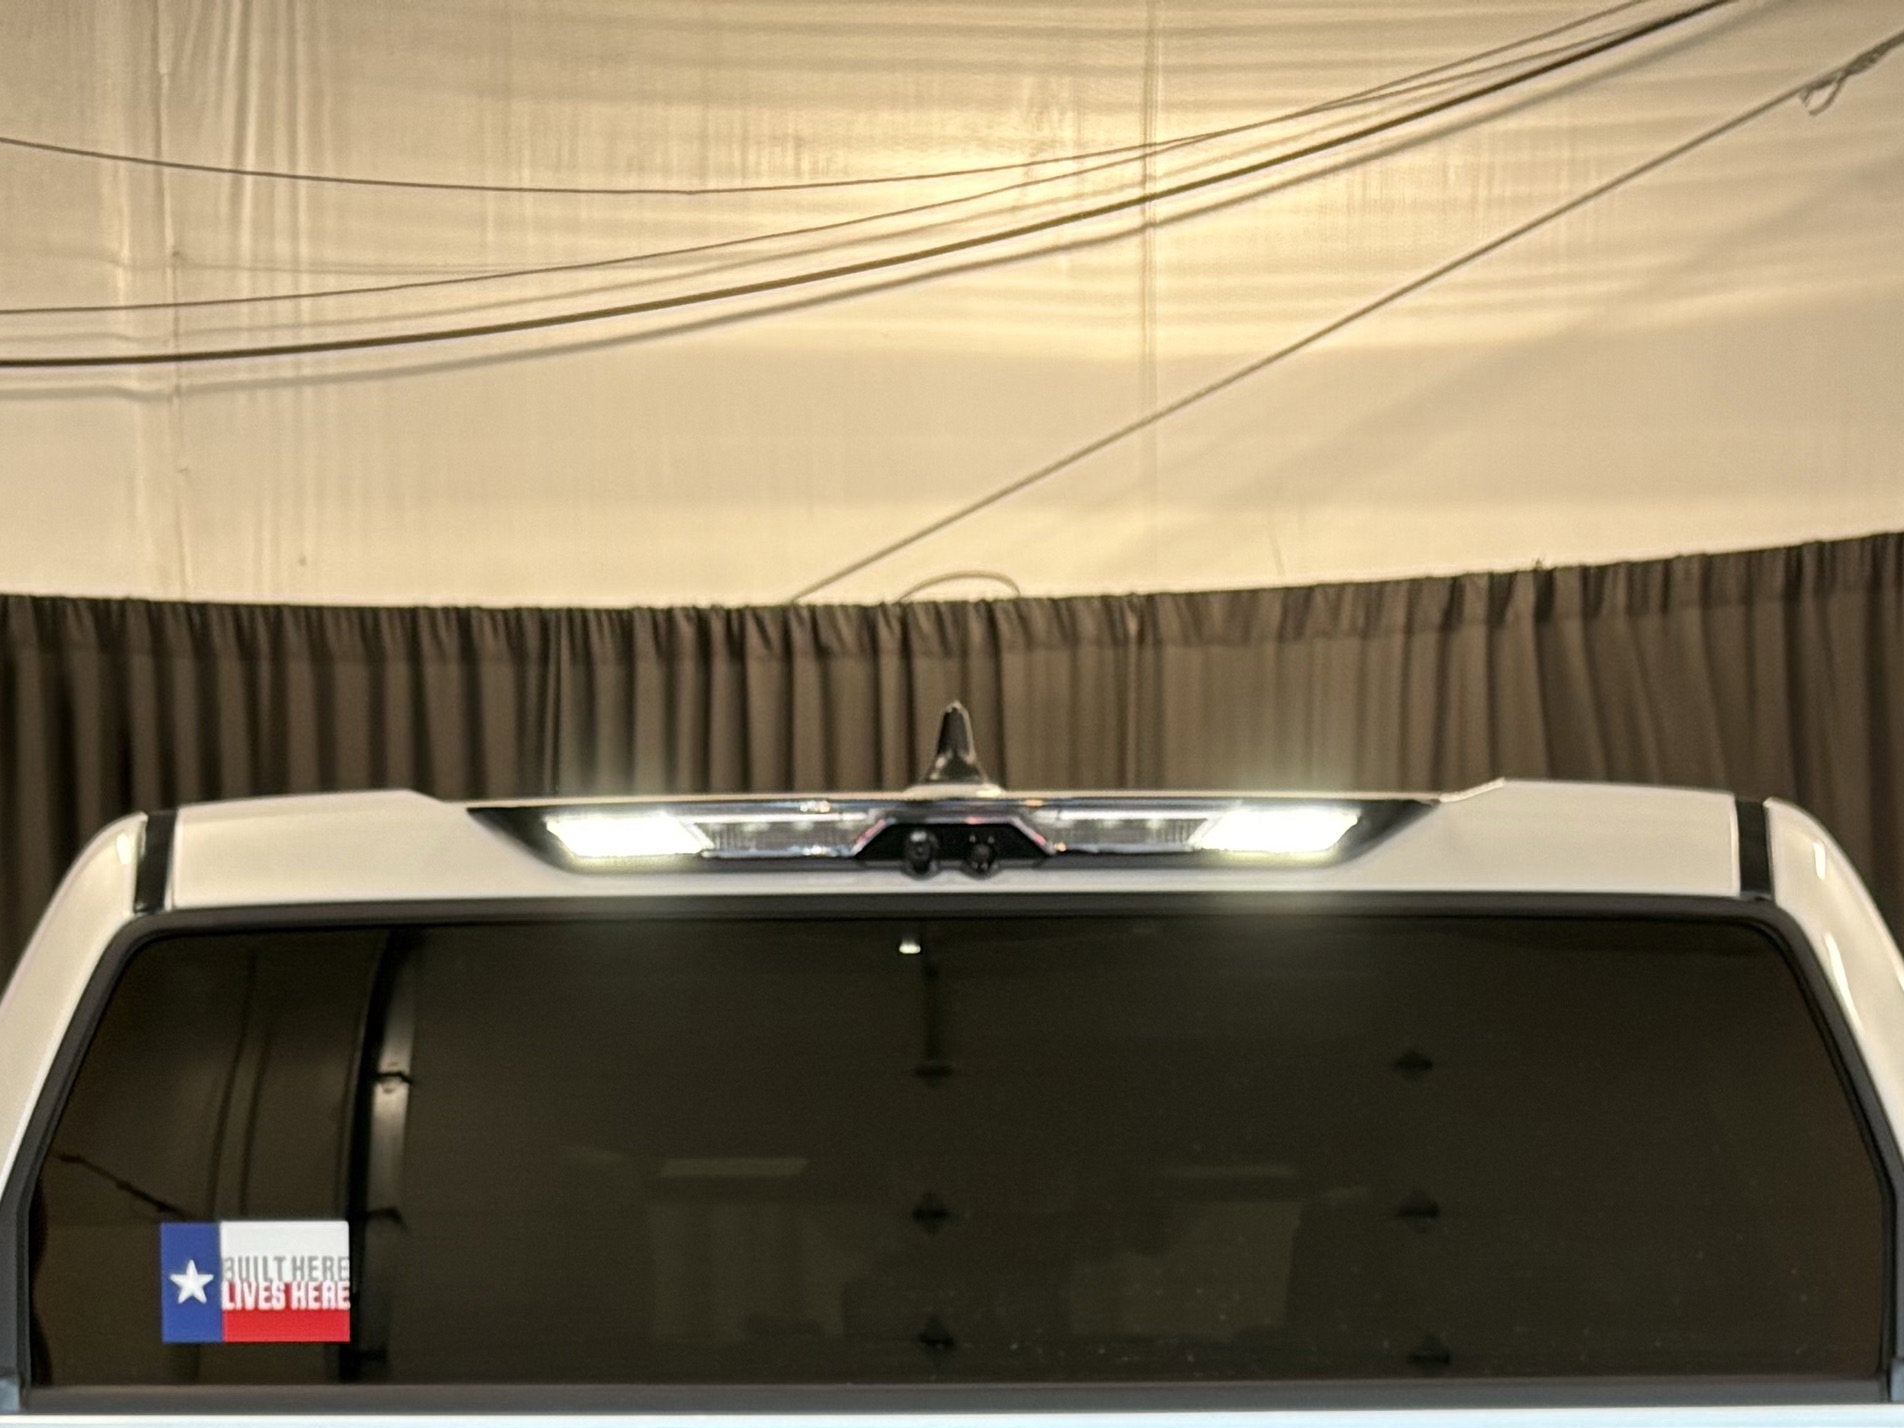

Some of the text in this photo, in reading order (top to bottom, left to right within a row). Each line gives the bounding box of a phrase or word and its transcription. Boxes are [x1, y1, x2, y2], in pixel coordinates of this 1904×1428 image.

[224, 1256, 350, 1281] BUILT HERE
[222, 1281, 351, 1311] LIVES HERE
